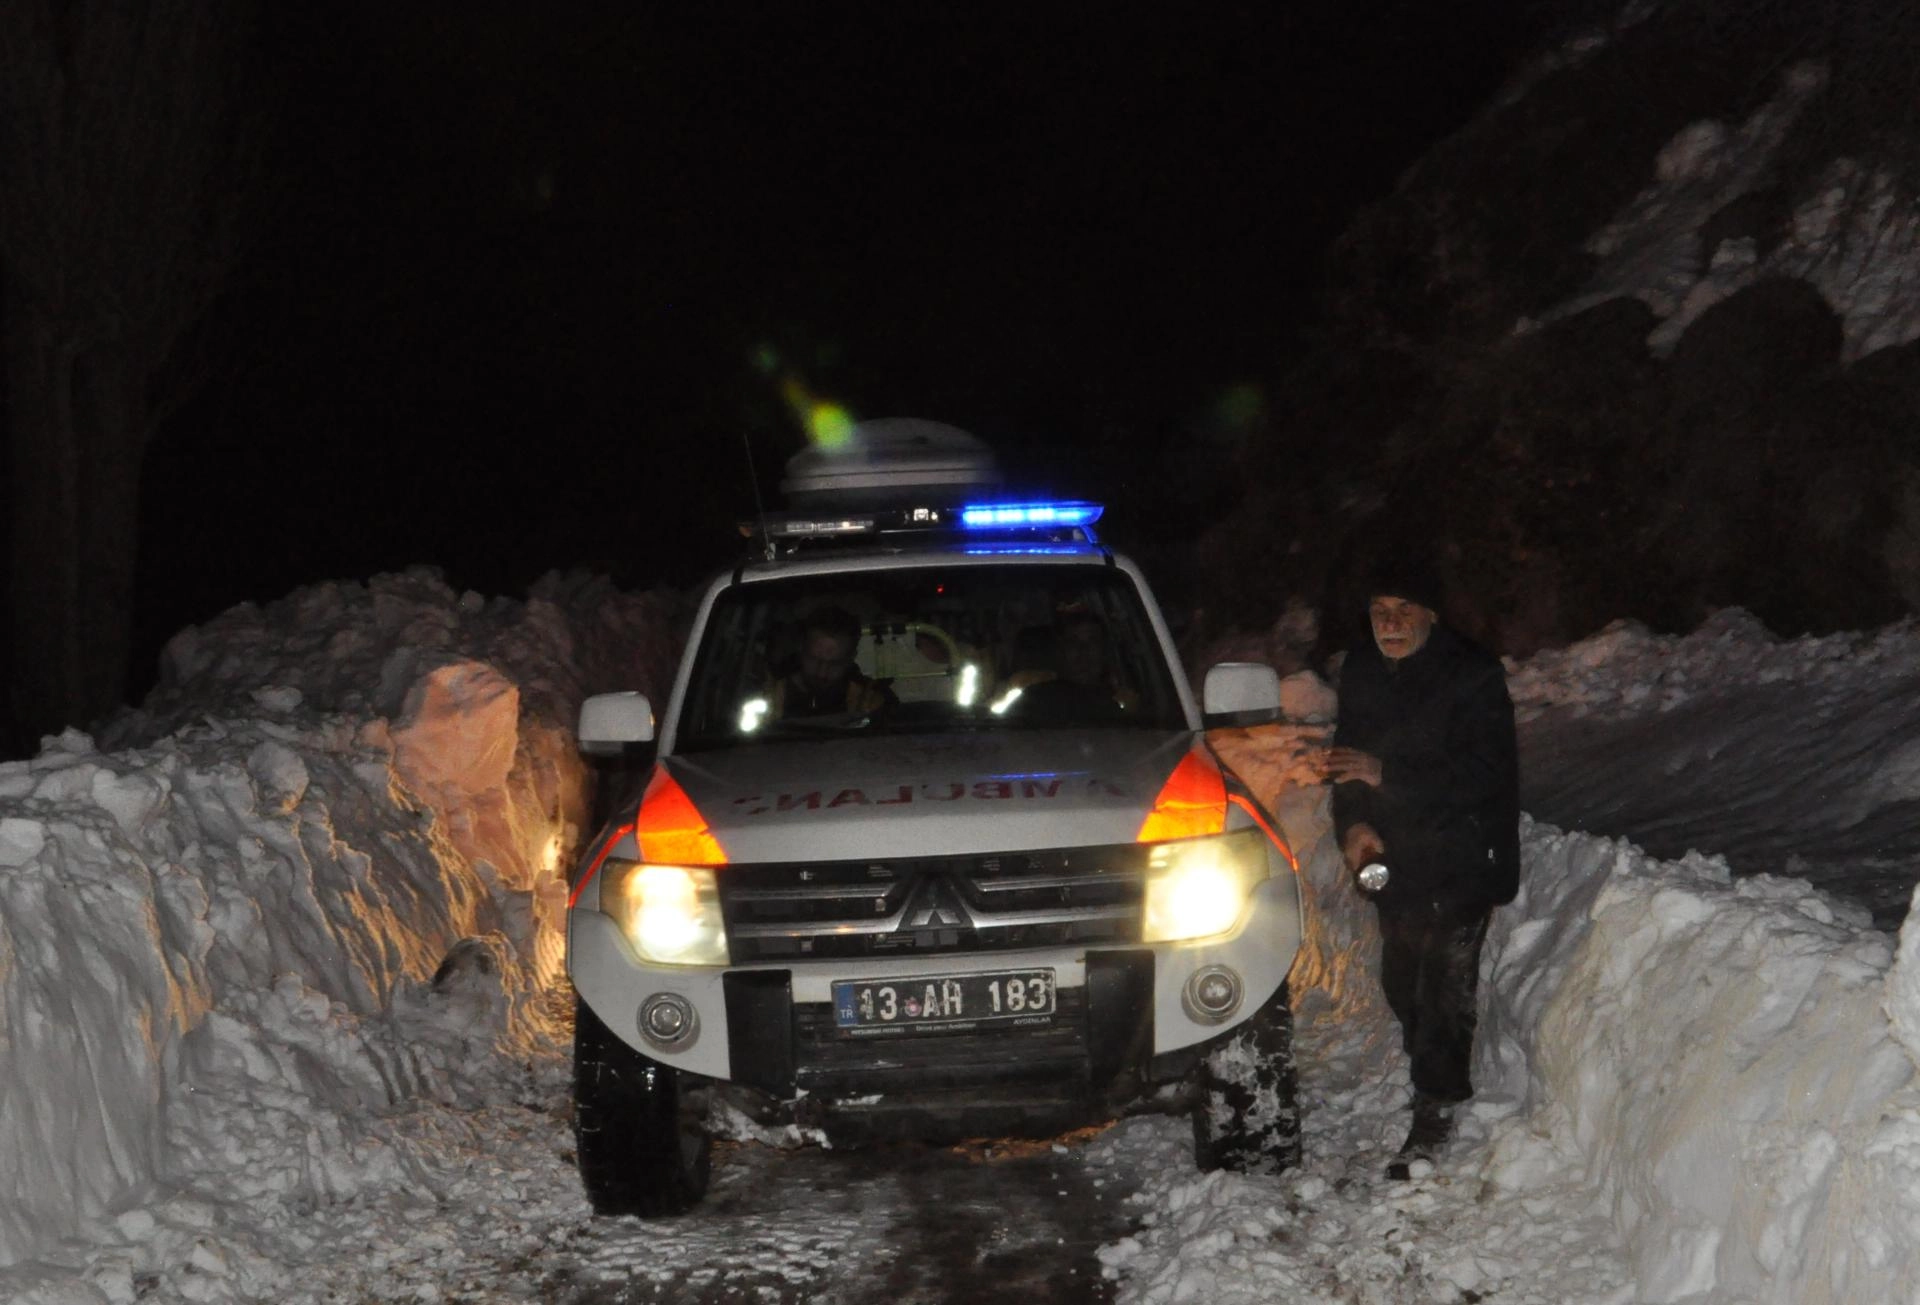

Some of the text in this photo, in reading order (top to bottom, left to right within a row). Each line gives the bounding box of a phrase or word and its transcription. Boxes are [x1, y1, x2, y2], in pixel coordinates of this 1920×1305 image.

[861, 978, 1047, 1020] 13 AH 183
[840, 1008, 854, 1020] TR
